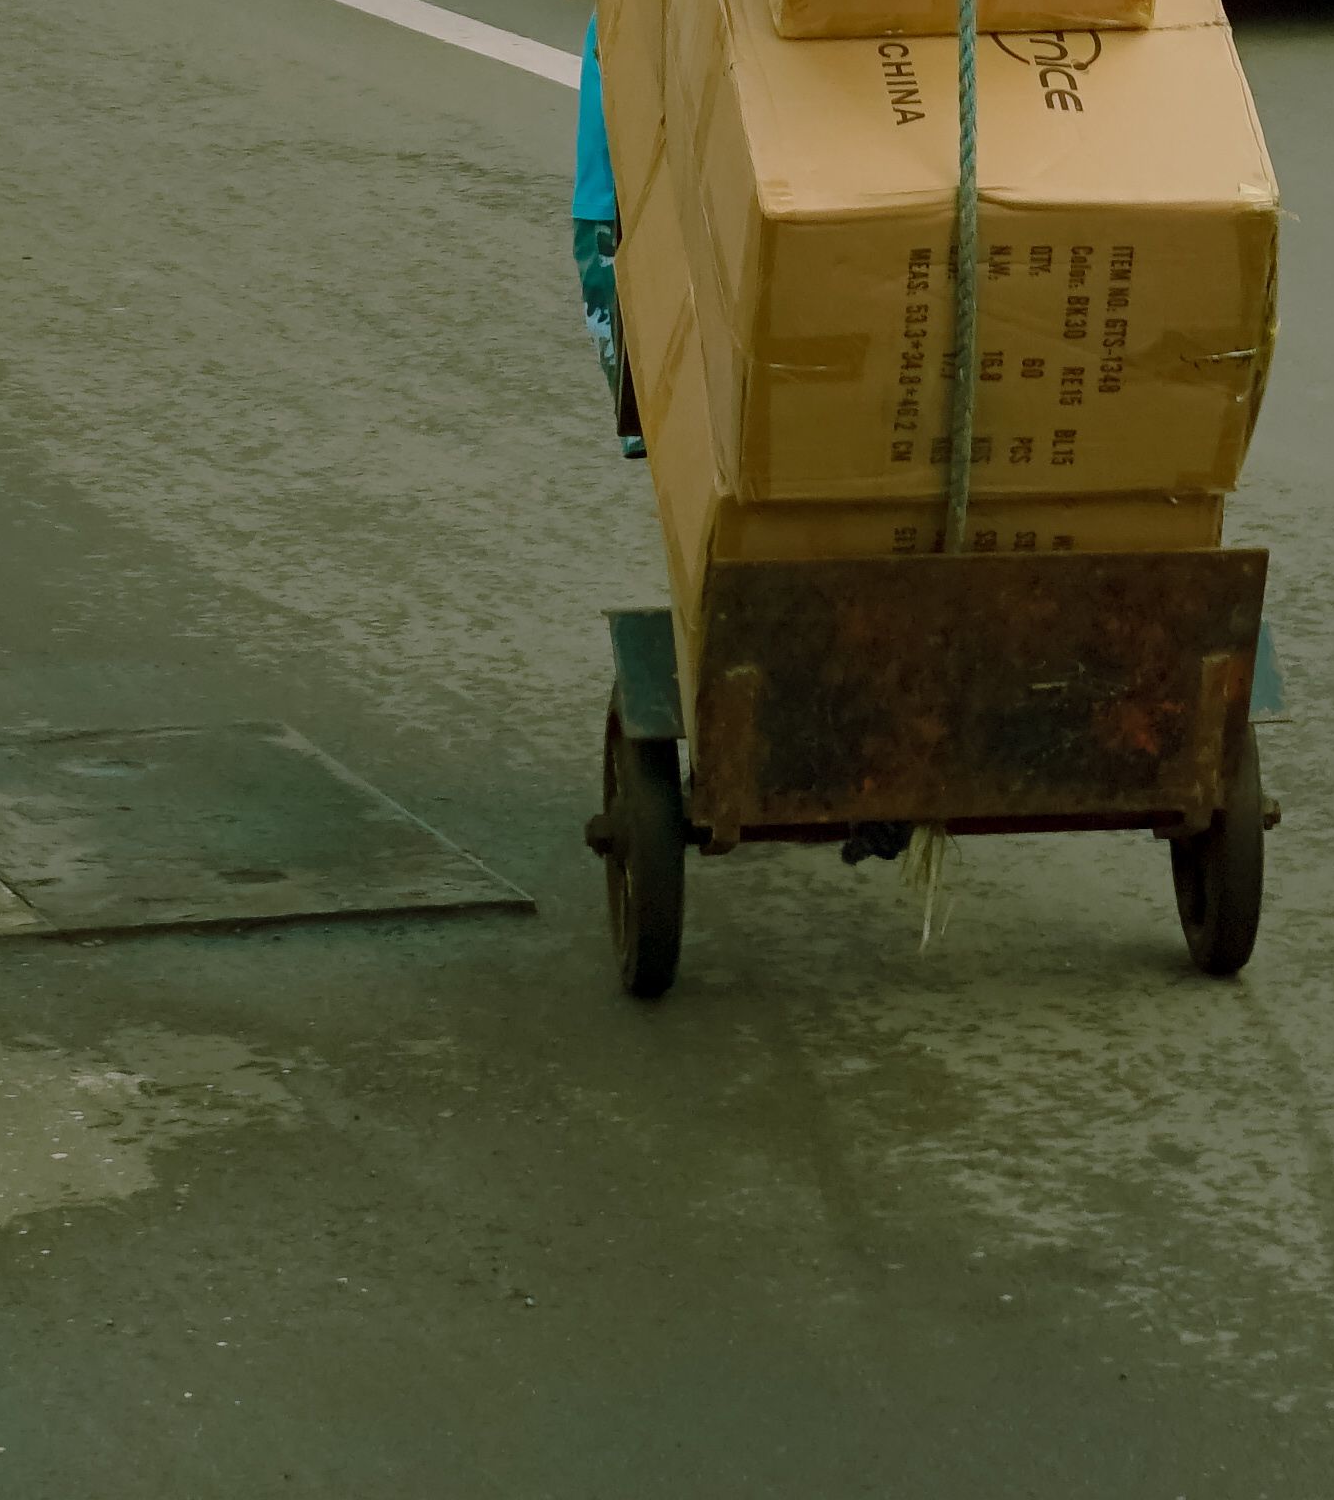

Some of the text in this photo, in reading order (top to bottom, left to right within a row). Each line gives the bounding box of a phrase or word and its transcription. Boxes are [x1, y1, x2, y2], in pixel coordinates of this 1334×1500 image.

[877, 41, 926, 126] CHINA
[1108, 245, 1134, 281] ITEM
[1062, 295, 1090, 340] BK30
[979, 350, 1004, 382] 16.8
[1020, 357, 1045, 380] 60
[1058, 366, 1086, 406] RE15
[890, 439, 914, 463] CM
